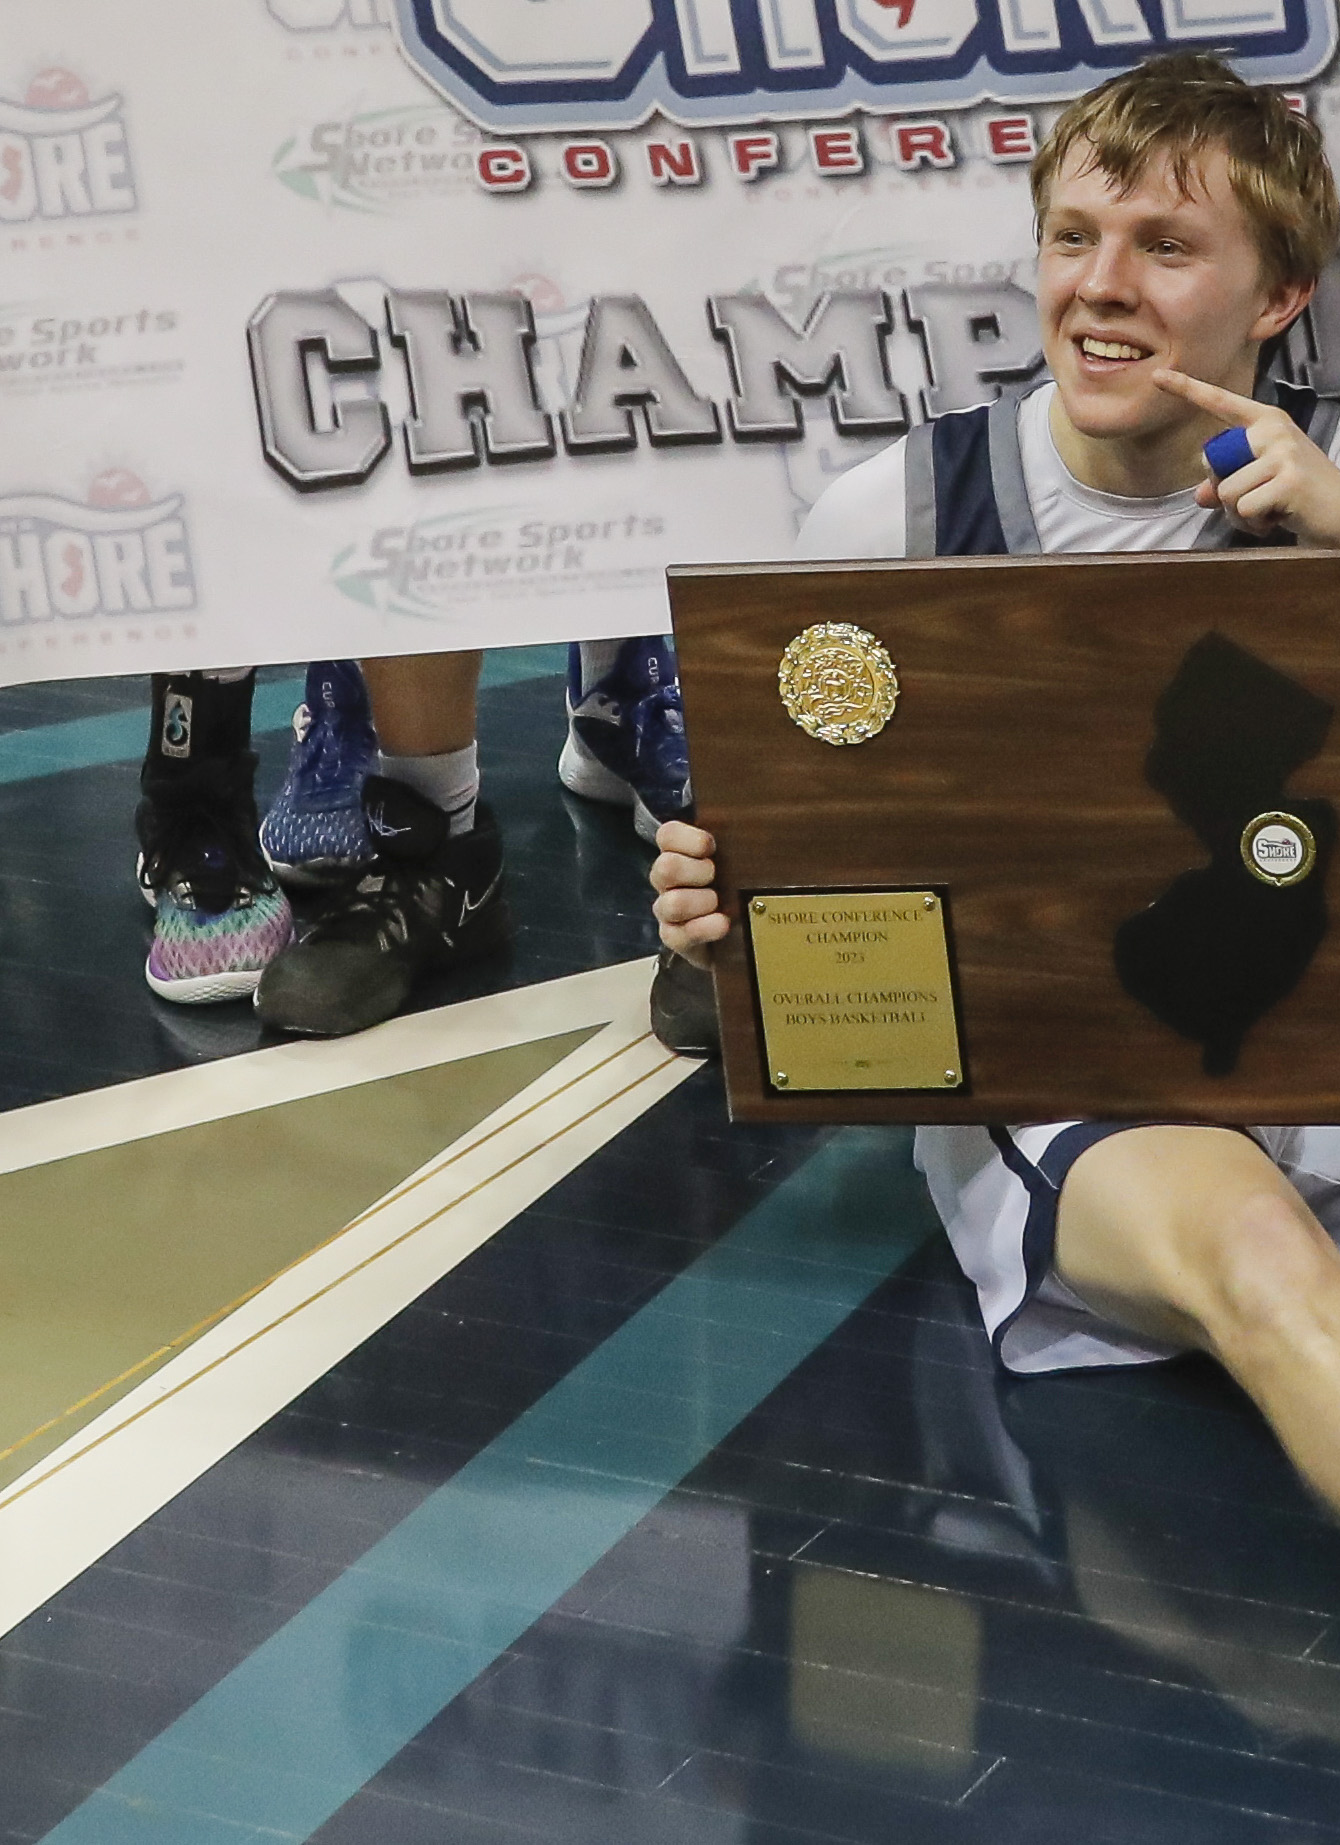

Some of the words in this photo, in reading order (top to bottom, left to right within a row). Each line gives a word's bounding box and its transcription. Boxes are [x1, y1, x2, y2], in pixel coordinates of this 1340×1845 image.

[0, 112, 139, 223] ORE
[350, 148, 478, 177] Netwo
[31, 308, 179, 346] Sports
[0, 342, 97, 372] work
[362, 525, 502, 574] Shore
[516, 512, 665, 549] Sports
[0, 508, 197, 626] HORE
[408, 544, 585, 583] Network
[768, 911, 818, 925] SHORE
[821, 909, 924, 924] CONFERENCE
[806, 931, 889, 944] CHAMPION
[835, 951, 866, 964] 2023
[772, 993, 841, 1005] OVERALL
[846, 990, 938, 1005] CHAMPIONS
[785, 1012, 827, 1025] BOYS
[830, 1010, 926, 1025] BASKETBALL
